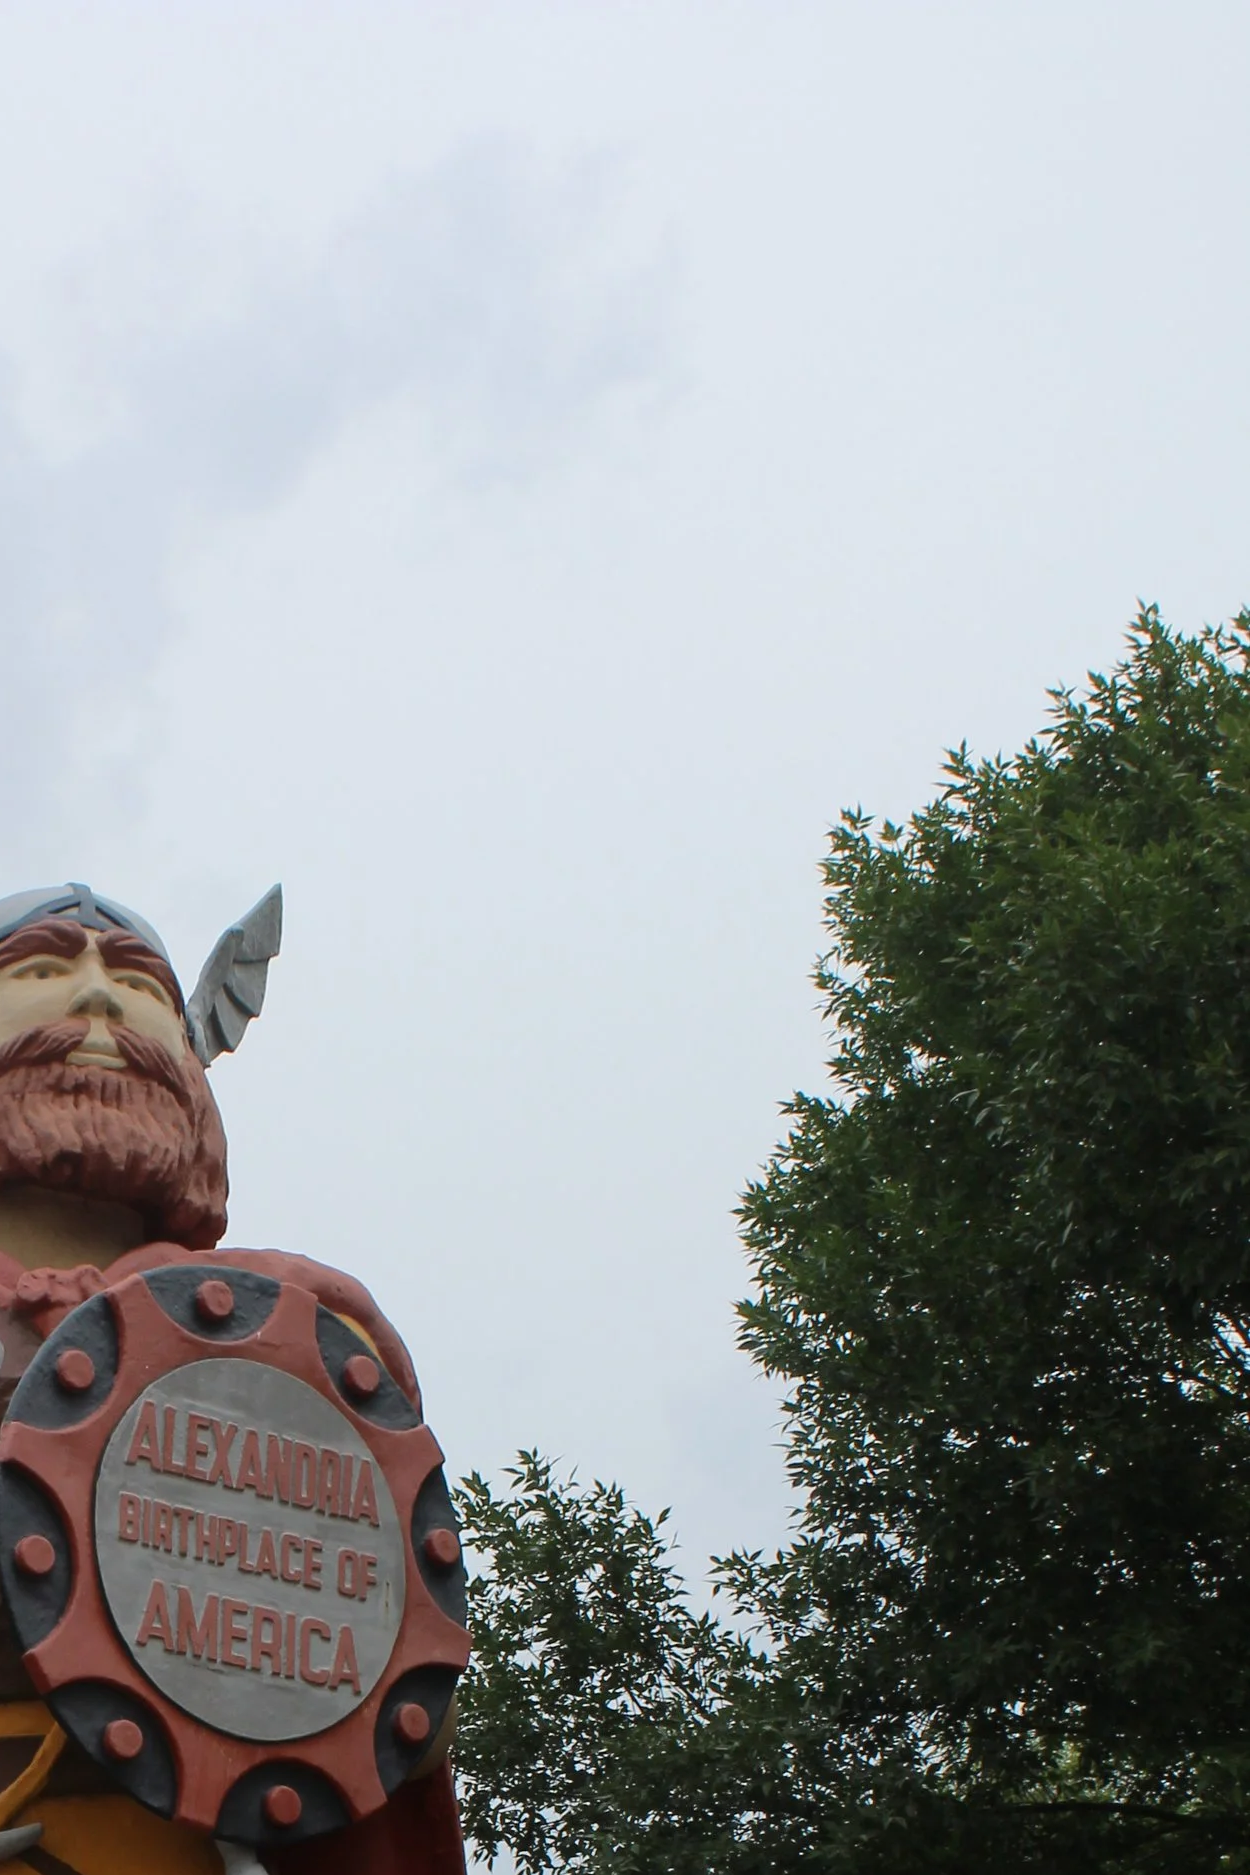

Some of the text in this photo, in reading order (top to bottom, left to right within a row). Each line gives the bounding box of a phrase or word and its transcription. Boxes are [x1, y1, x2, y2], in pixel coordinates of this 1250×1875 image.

[125, 1400, 380, 1528] ALEXANDRIA
[118, 1491, 378, 1602] BIRTHPLACE OF
[135, 1579, 362, 1695] AMERICA
